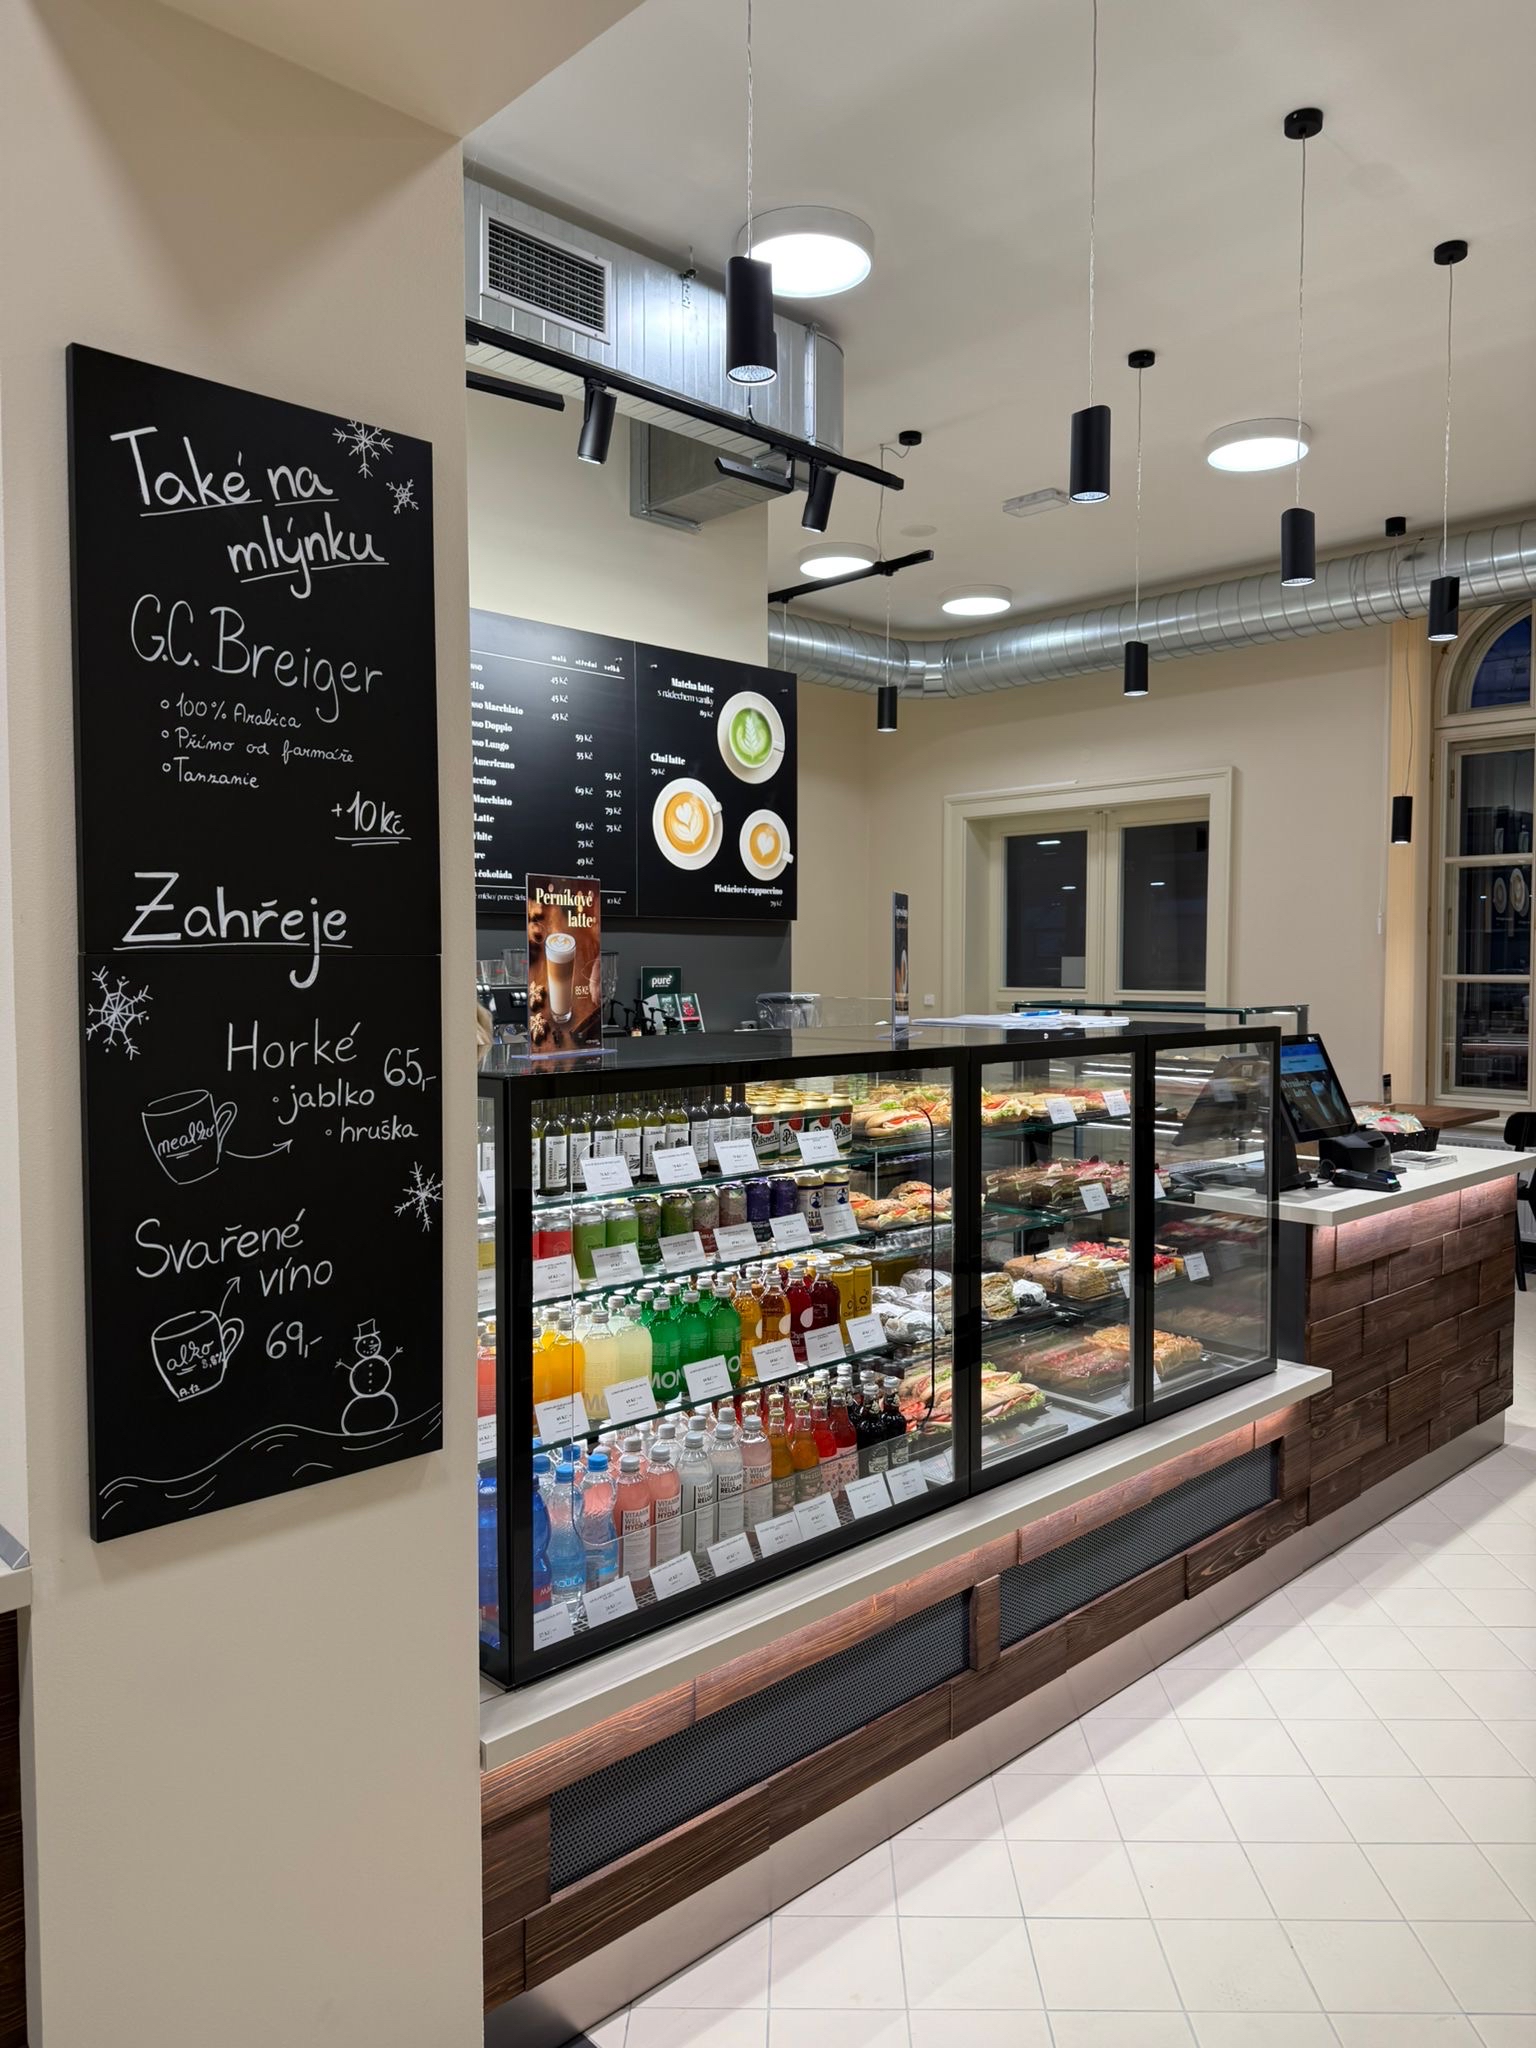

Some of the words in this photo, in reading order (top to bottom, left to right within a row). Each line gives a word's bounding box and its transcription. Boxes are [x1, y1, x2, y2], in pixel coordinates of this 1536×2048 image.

[110, 426, 251, 506] Také
[267, 464, 333, 500] na
[227, 511, 385, 599] mlýnku
[210, 607, 383, 723] Breiger
[671, 677, 697, 690] Matcha
[697, 681, 714, 693] latte
[176, 693, 227, 720] 100%
[233, 702, 301, 729] Arabica
[484, 720, 513, 733] Doppio
[175, 726, 235, 752] Přímo
[246, 742, 269, 756] od
[281, 739, 354, 765] farmáře
[484, 739, 510, 752] Lungo
[650, 752, 668, 763] Chai
[668, 754, 686, 765] latte
[173, 756, 260, 789] Tanzanie
[472, 756, 515, 769] Americano
[535, 886, 593, 908] Perníkové
[714, 884, 747, 894] Pistáciové
[747, 886, 783, 896] cappuccino
[122, 872, 348, 989] Zahřeje
[568, 910, 593, 928] latte
[651, 977, 671, 988] pure
[227, 1018, 361, 1071] Horké
[277, 1077, 375, 1125] jablko
[340, 1114, 419, 1143] hruška
[136, 1208, 306, 1278] Svařené
[259, 1257, 333, 1297] víno
